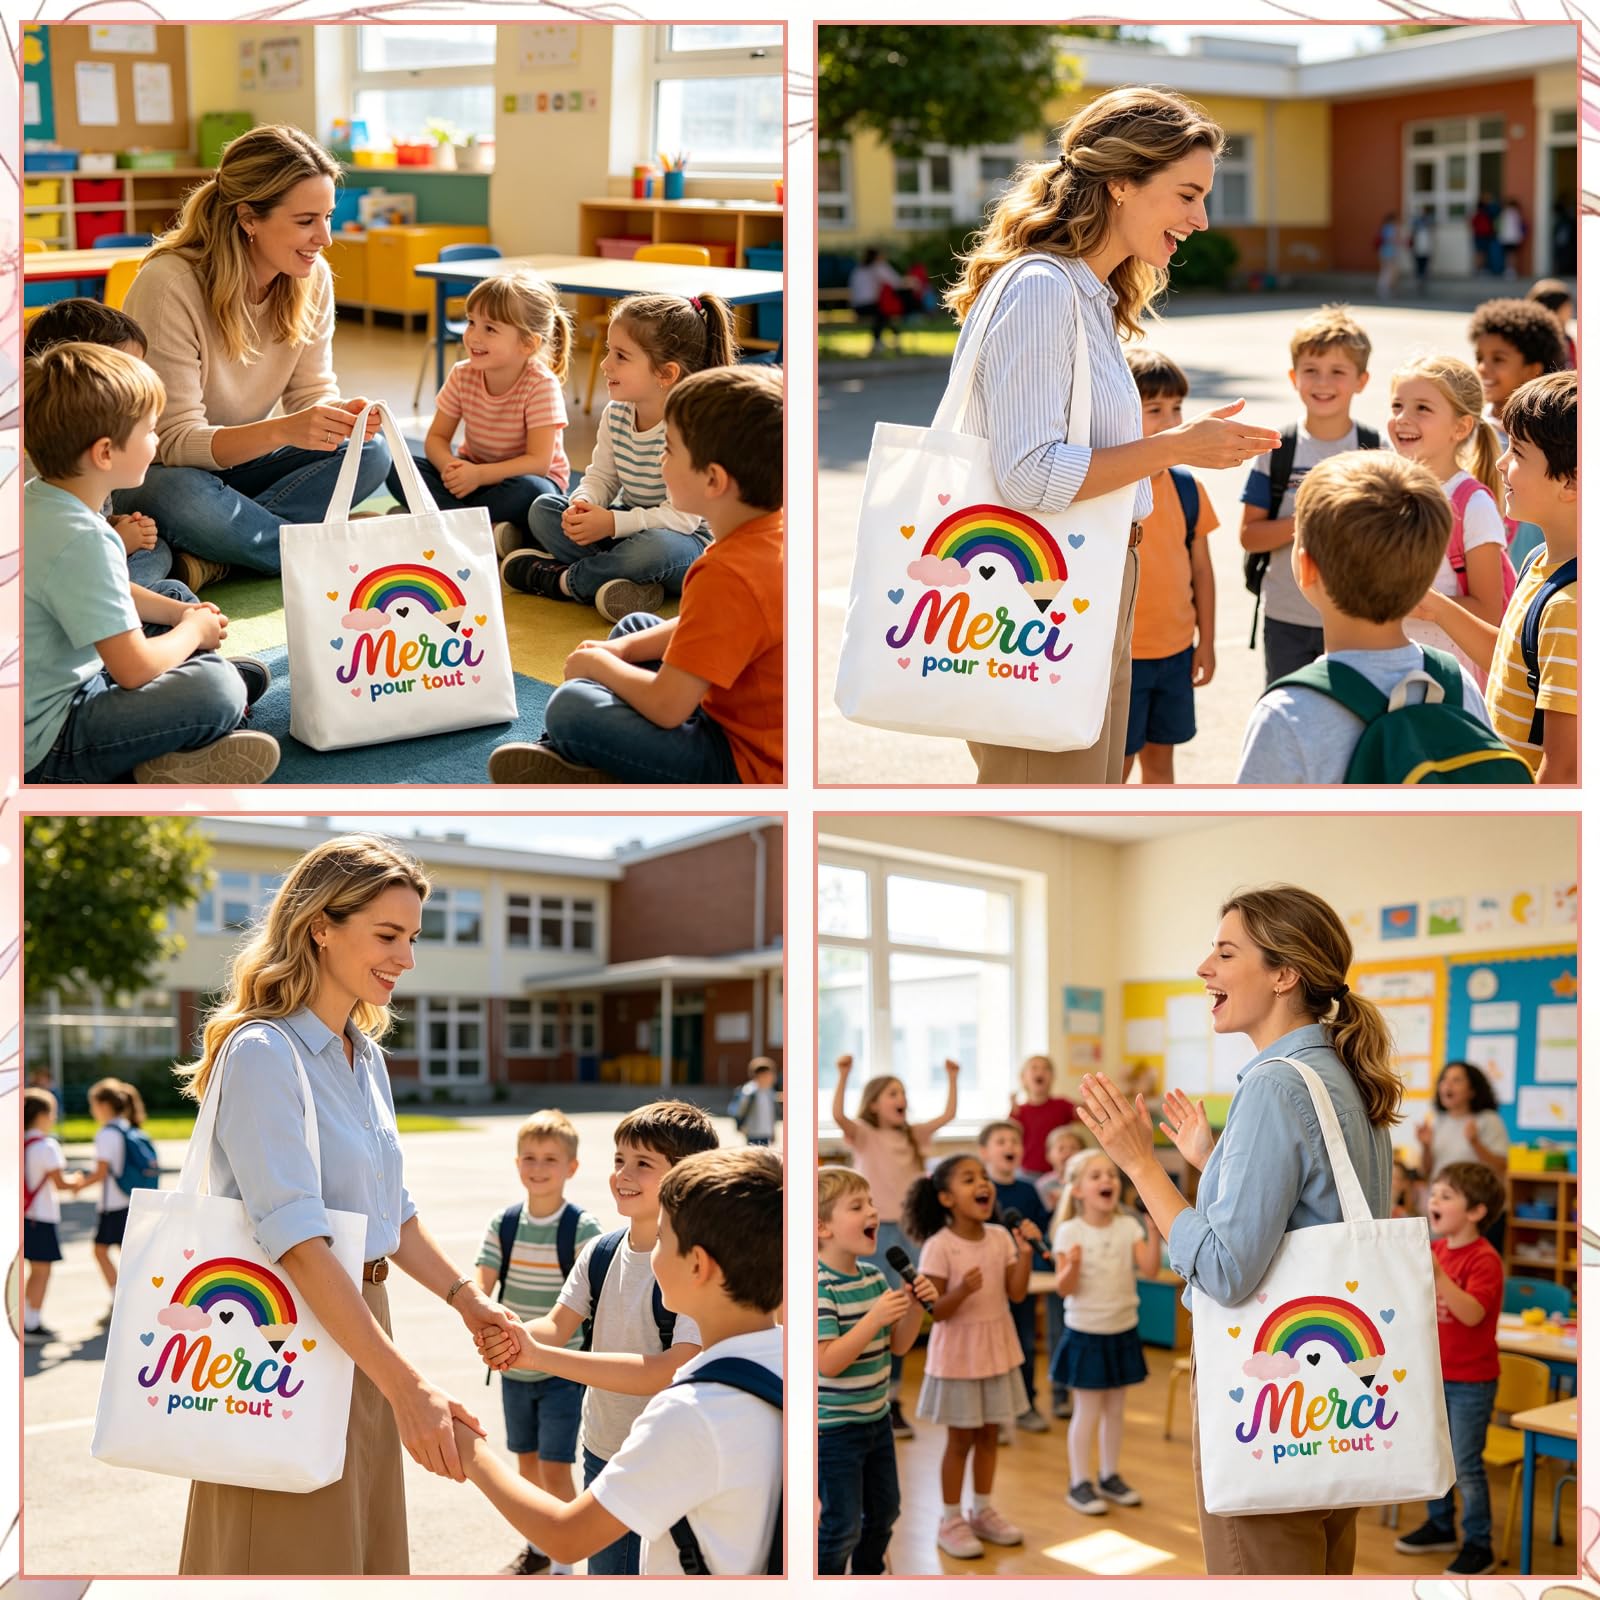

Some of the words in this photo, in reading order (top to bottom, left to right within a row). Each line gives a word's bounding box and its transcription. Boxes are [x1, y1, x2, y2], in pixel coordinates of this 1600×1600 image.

[885, 589, 1074, 662] Merci
[336, 629, 485, 684] Merci
[922, 656, 980, 677] pour
[986, 658, 1040, 682] tout
[370, 678, 416, 702] pour
[421, 670, 466, 690] tout
[137, 1333, 305, 1399] Merci
[167, 1394, 219, 1414] pour
[224, 1395, 273, 1418] tout
[1235, 1380, 1399, 1443] Merci
[1272, 1440, 1322, 1464] pour
[1328, 1433, 1375, 1454] tout
